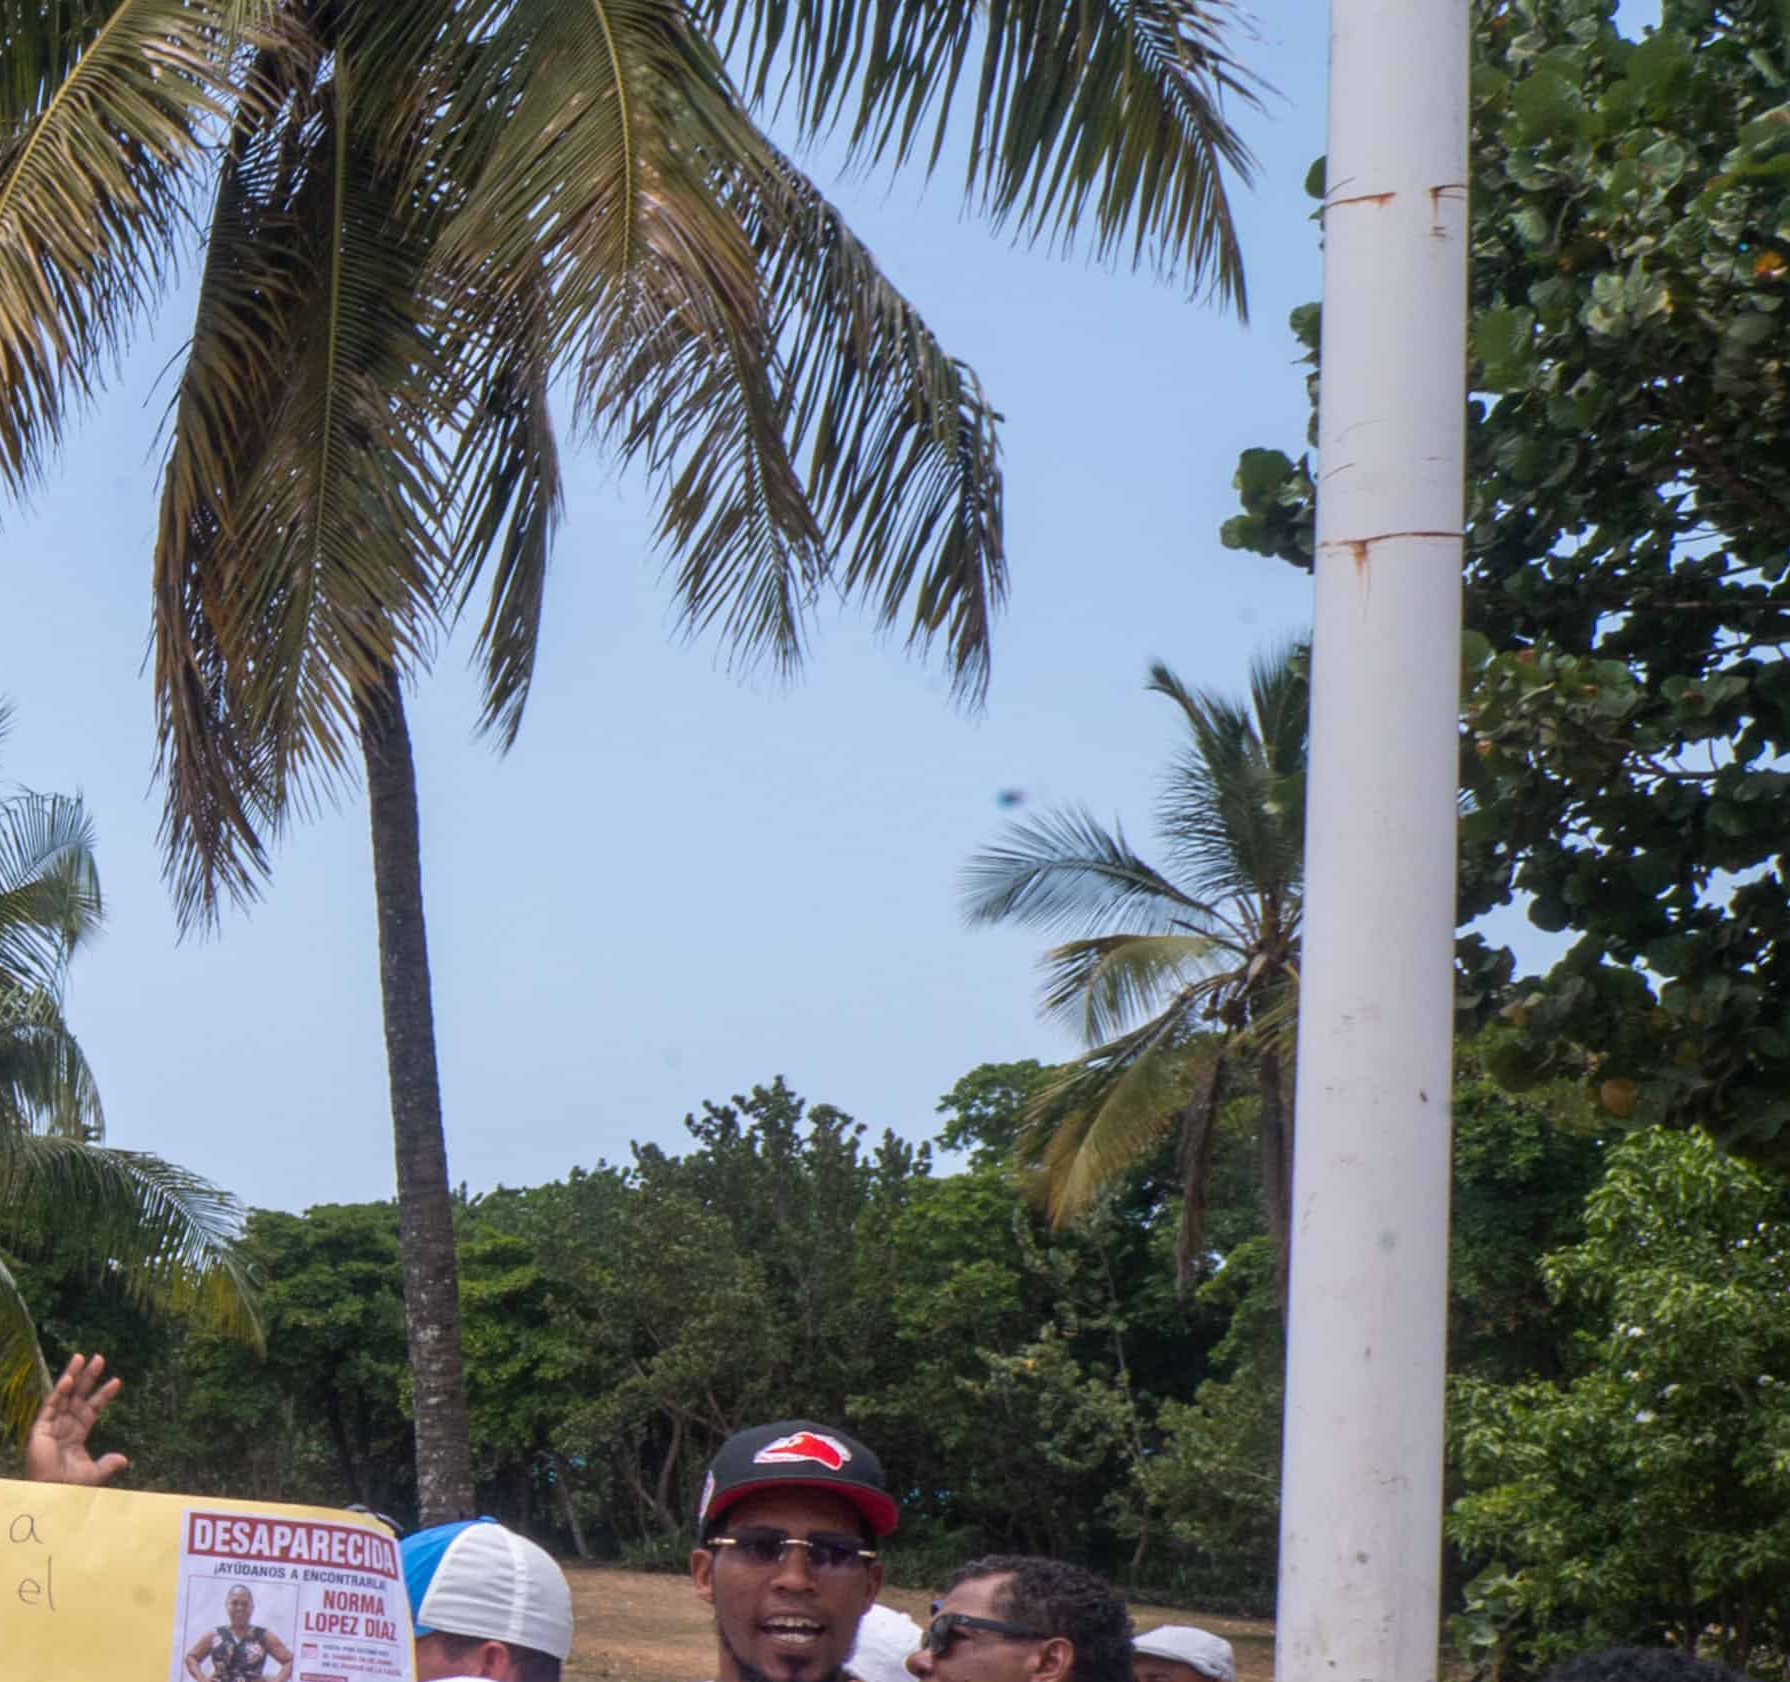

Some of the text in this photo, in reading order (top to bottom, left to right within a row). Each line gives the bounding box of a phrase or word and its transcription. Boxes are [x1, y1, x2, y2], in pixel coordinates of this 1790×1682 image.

[9, 1514, 43, 1544] a
[193, 1518, 394, 1576] DESAPARECIDA
[17, 1555, 56, 1612] el
[214, 1561, 286, 1579] ¡AYÚDANOS
[290, 1569, 299, 1580] A
[323, 1589, 385, 1617] NORMA
[304, 1612, 397, 1641] LOPEZ DIAZ
